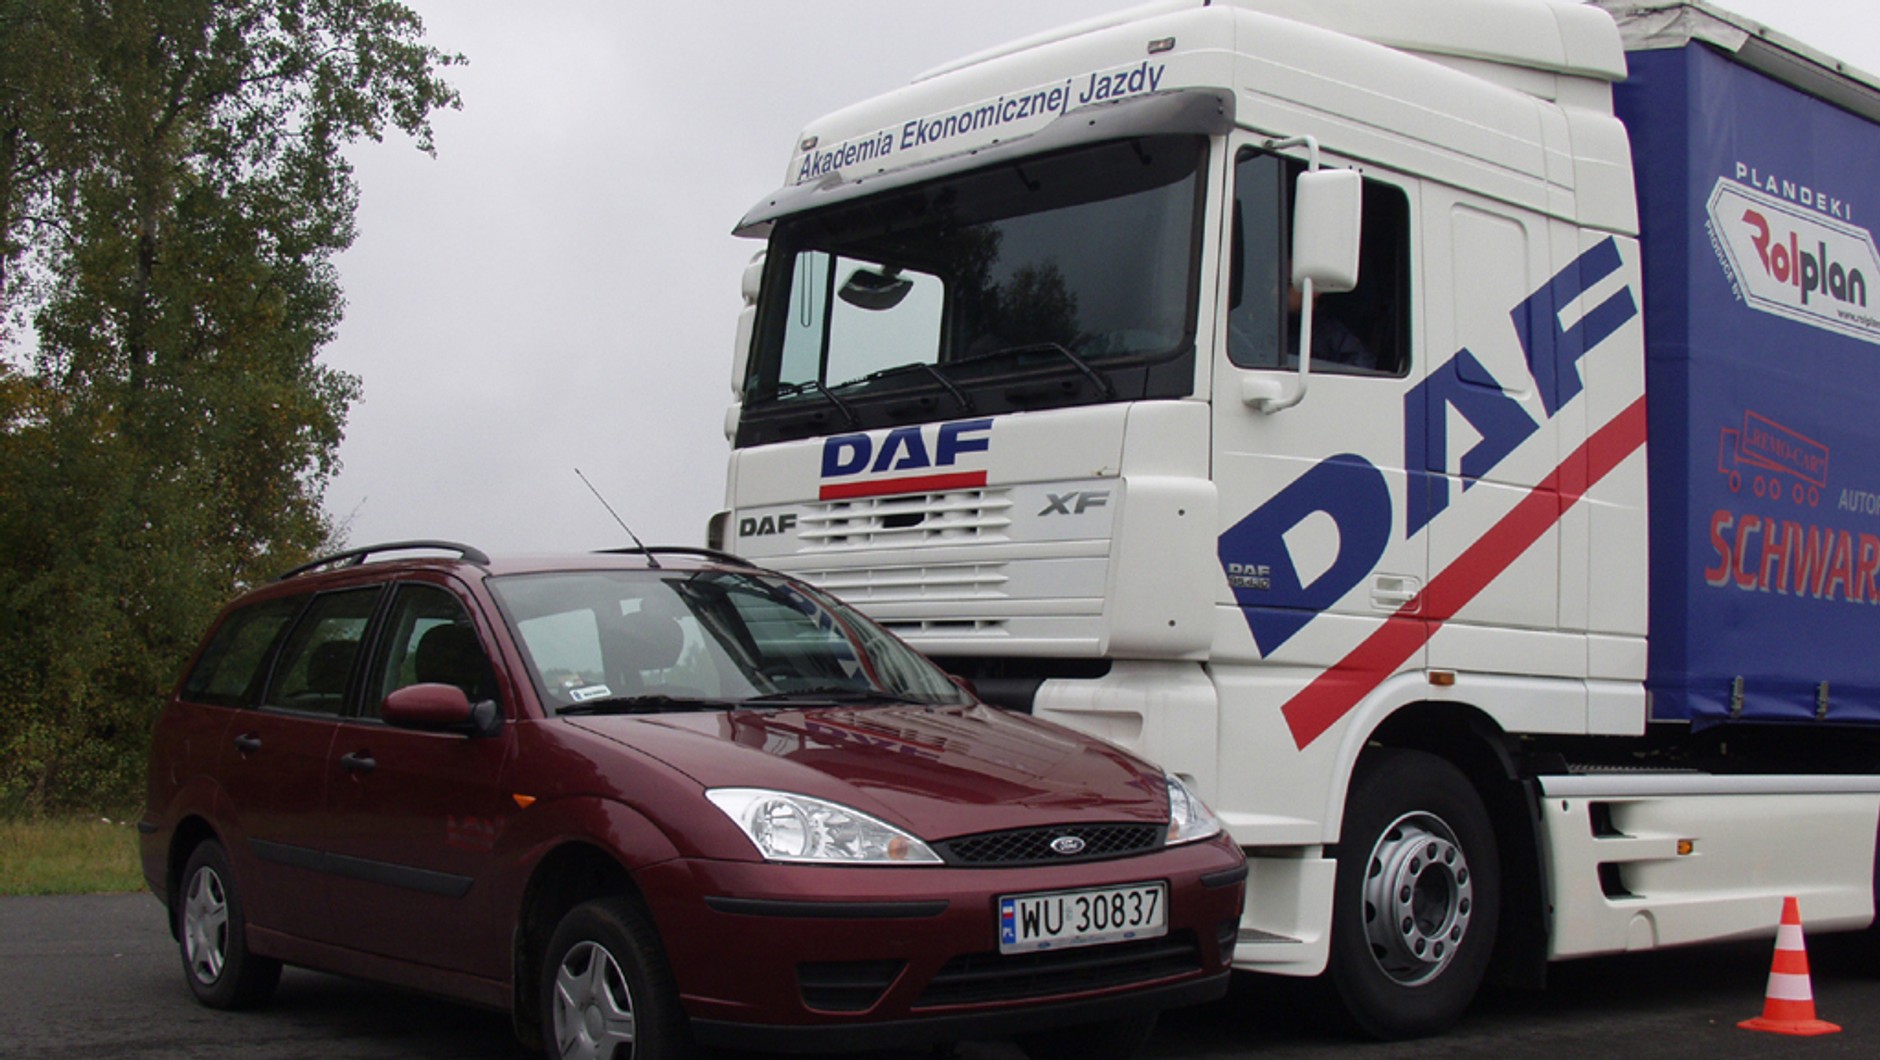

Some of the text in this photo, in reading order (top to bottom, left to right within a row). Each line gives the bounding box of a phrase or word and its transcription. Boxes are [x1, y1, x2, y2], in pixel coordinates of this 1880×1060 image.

[799, 60, 1165, 180] Akademia Ekonomicznej Jazdy
[1736, 161, 1851, 221] PLANDEKI
[1741, 208, 1867, 308] Rolplan
[820, 418, 994, 478] DAF
[1217, 235, 1638, 660] DAF
[739, 513, 798, 537] DAF
[1037, 490, 1111, 517] XF
[1228, 563, 1270, 576] DAF
[1704, 509, 1880, 605] SCHWAR
[1020, 889, 1159, 939] WU 30837
